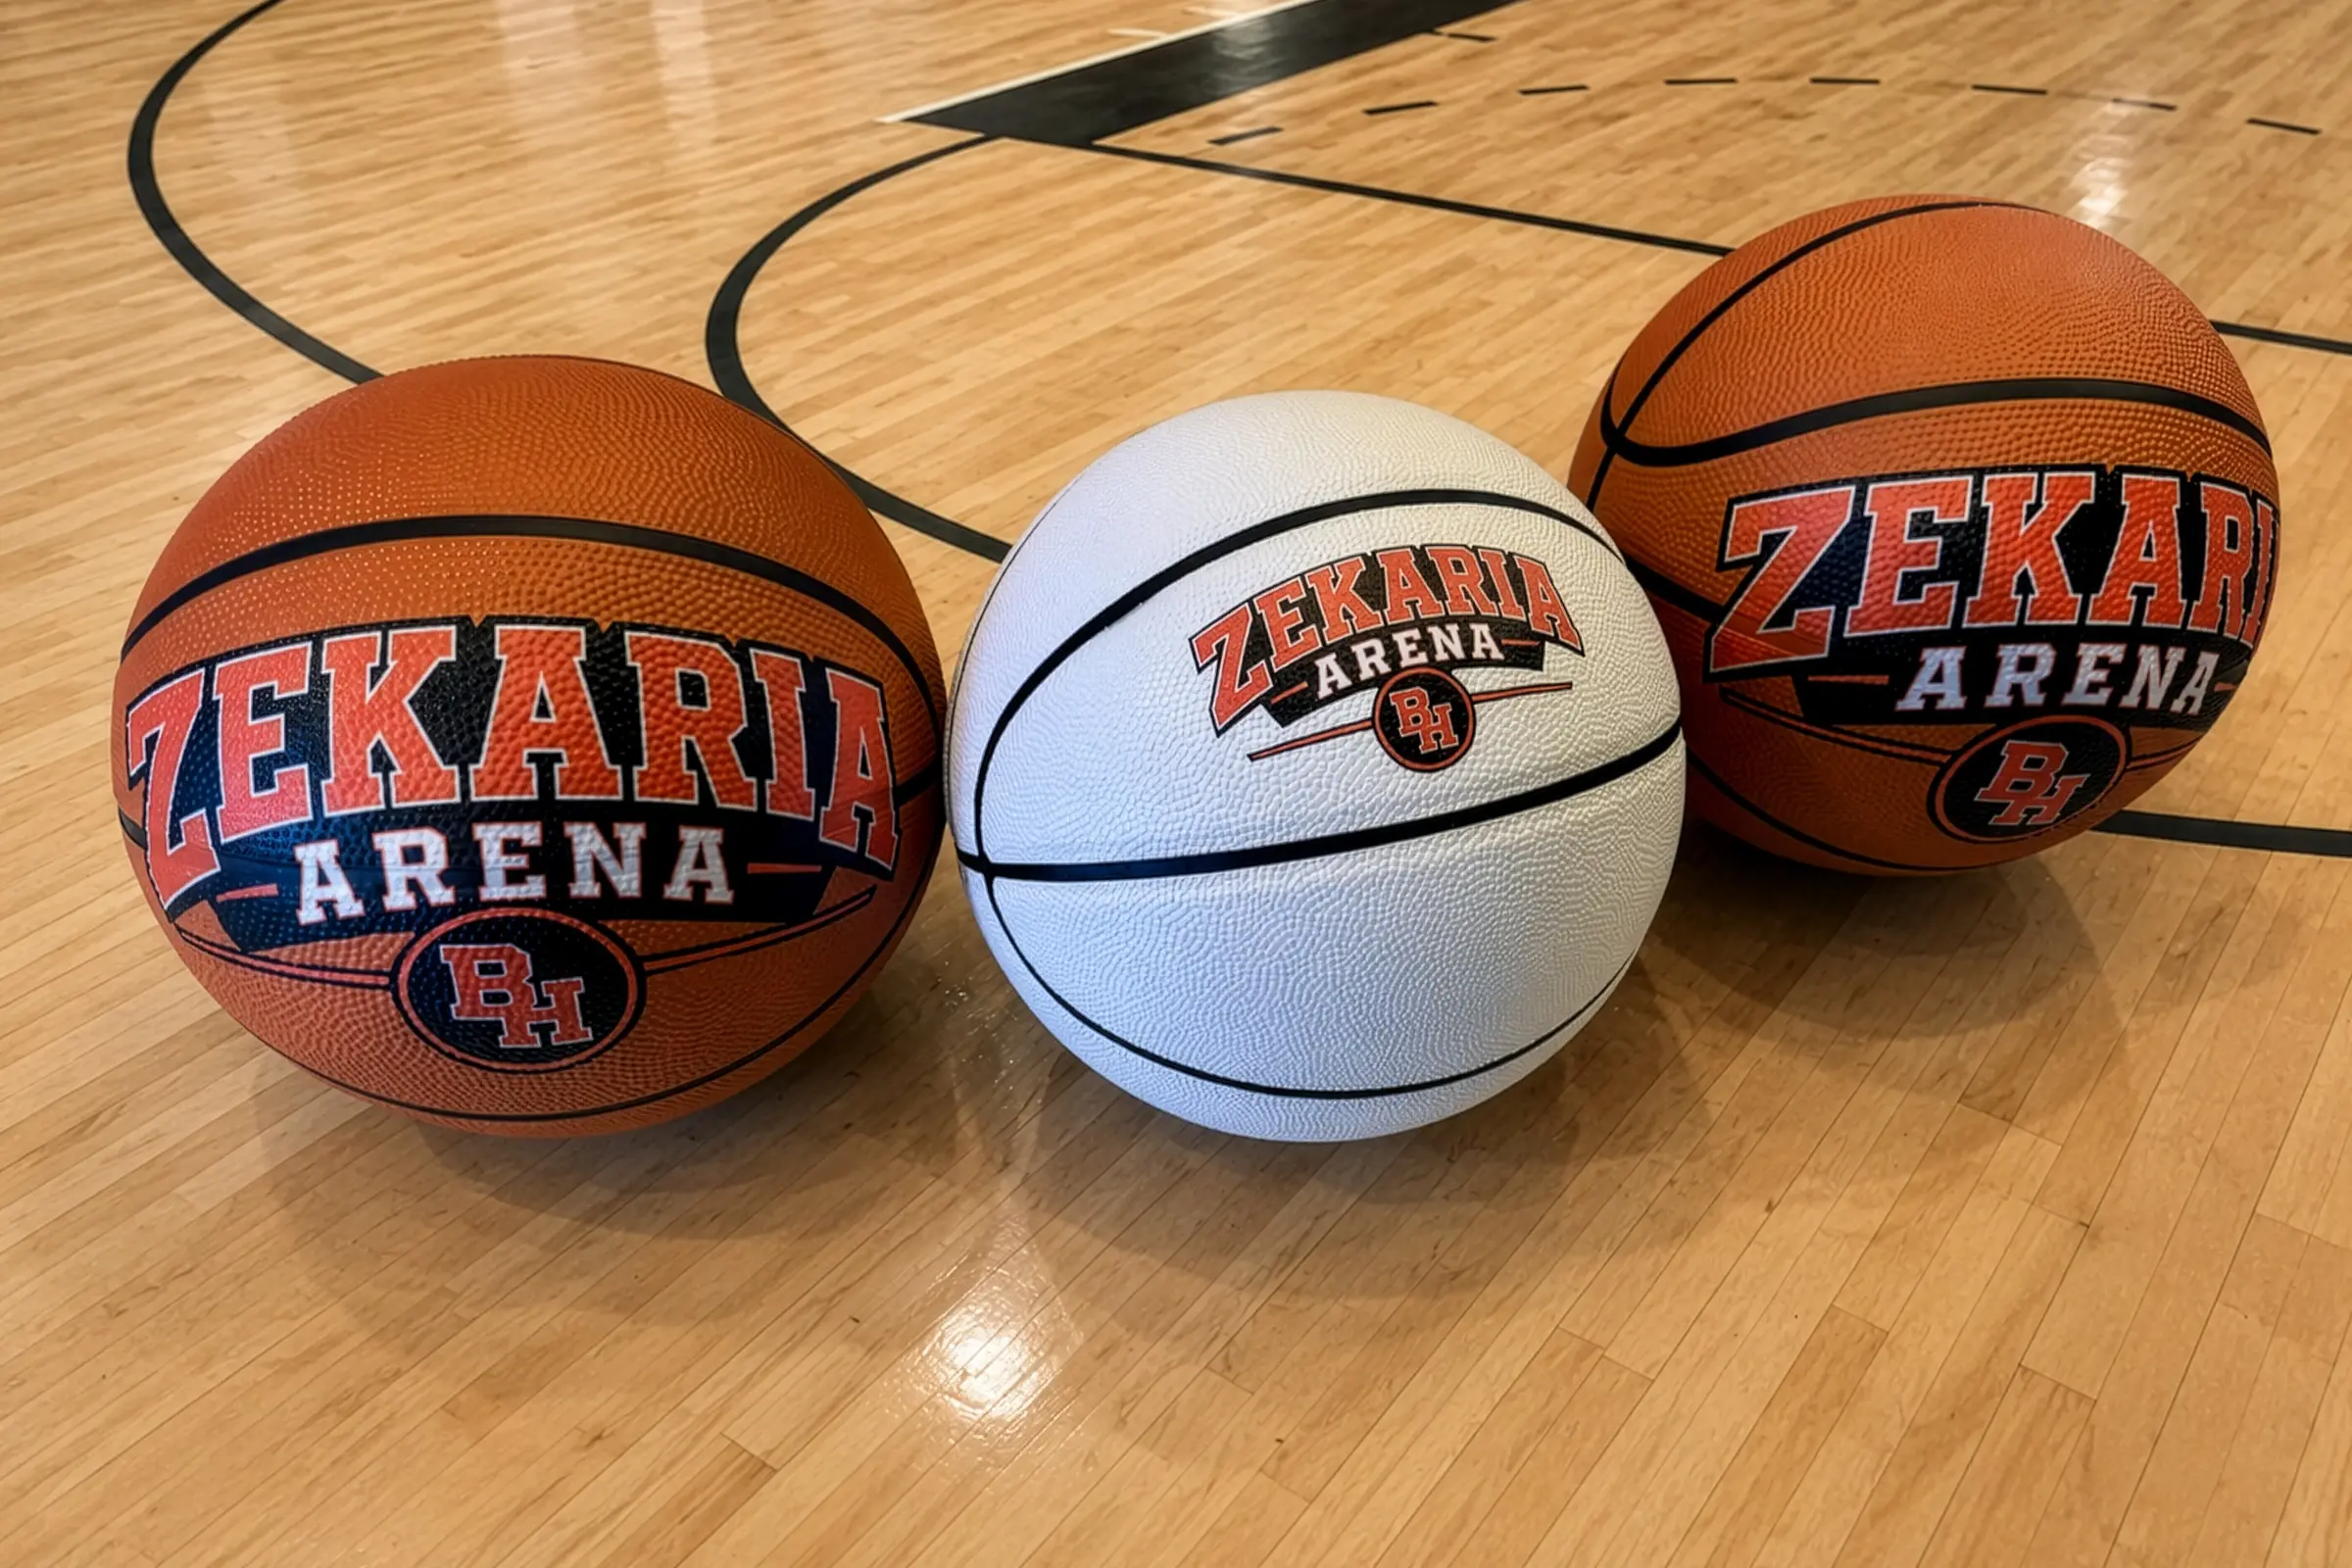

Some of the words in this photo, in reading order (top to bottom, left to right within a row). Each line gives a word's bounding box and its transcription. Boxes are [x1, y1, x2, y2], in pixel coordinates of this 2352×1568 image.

[1710, 472, 2278, 671] ZEKARI
[1194, 546, 1581, 729] ZEKARIA
[1317, 622, 1504, 700] ARENA
[1895, 642, 2221, 715] ARENA
[127, 624, 899, 911] ZEKARIA
[1390, 688, 1459, 755] BH
[1975, 740, 2090, 827] BH
[293, 820, 734, 926] ARENA
[439, 943, 593, 1049] BH
